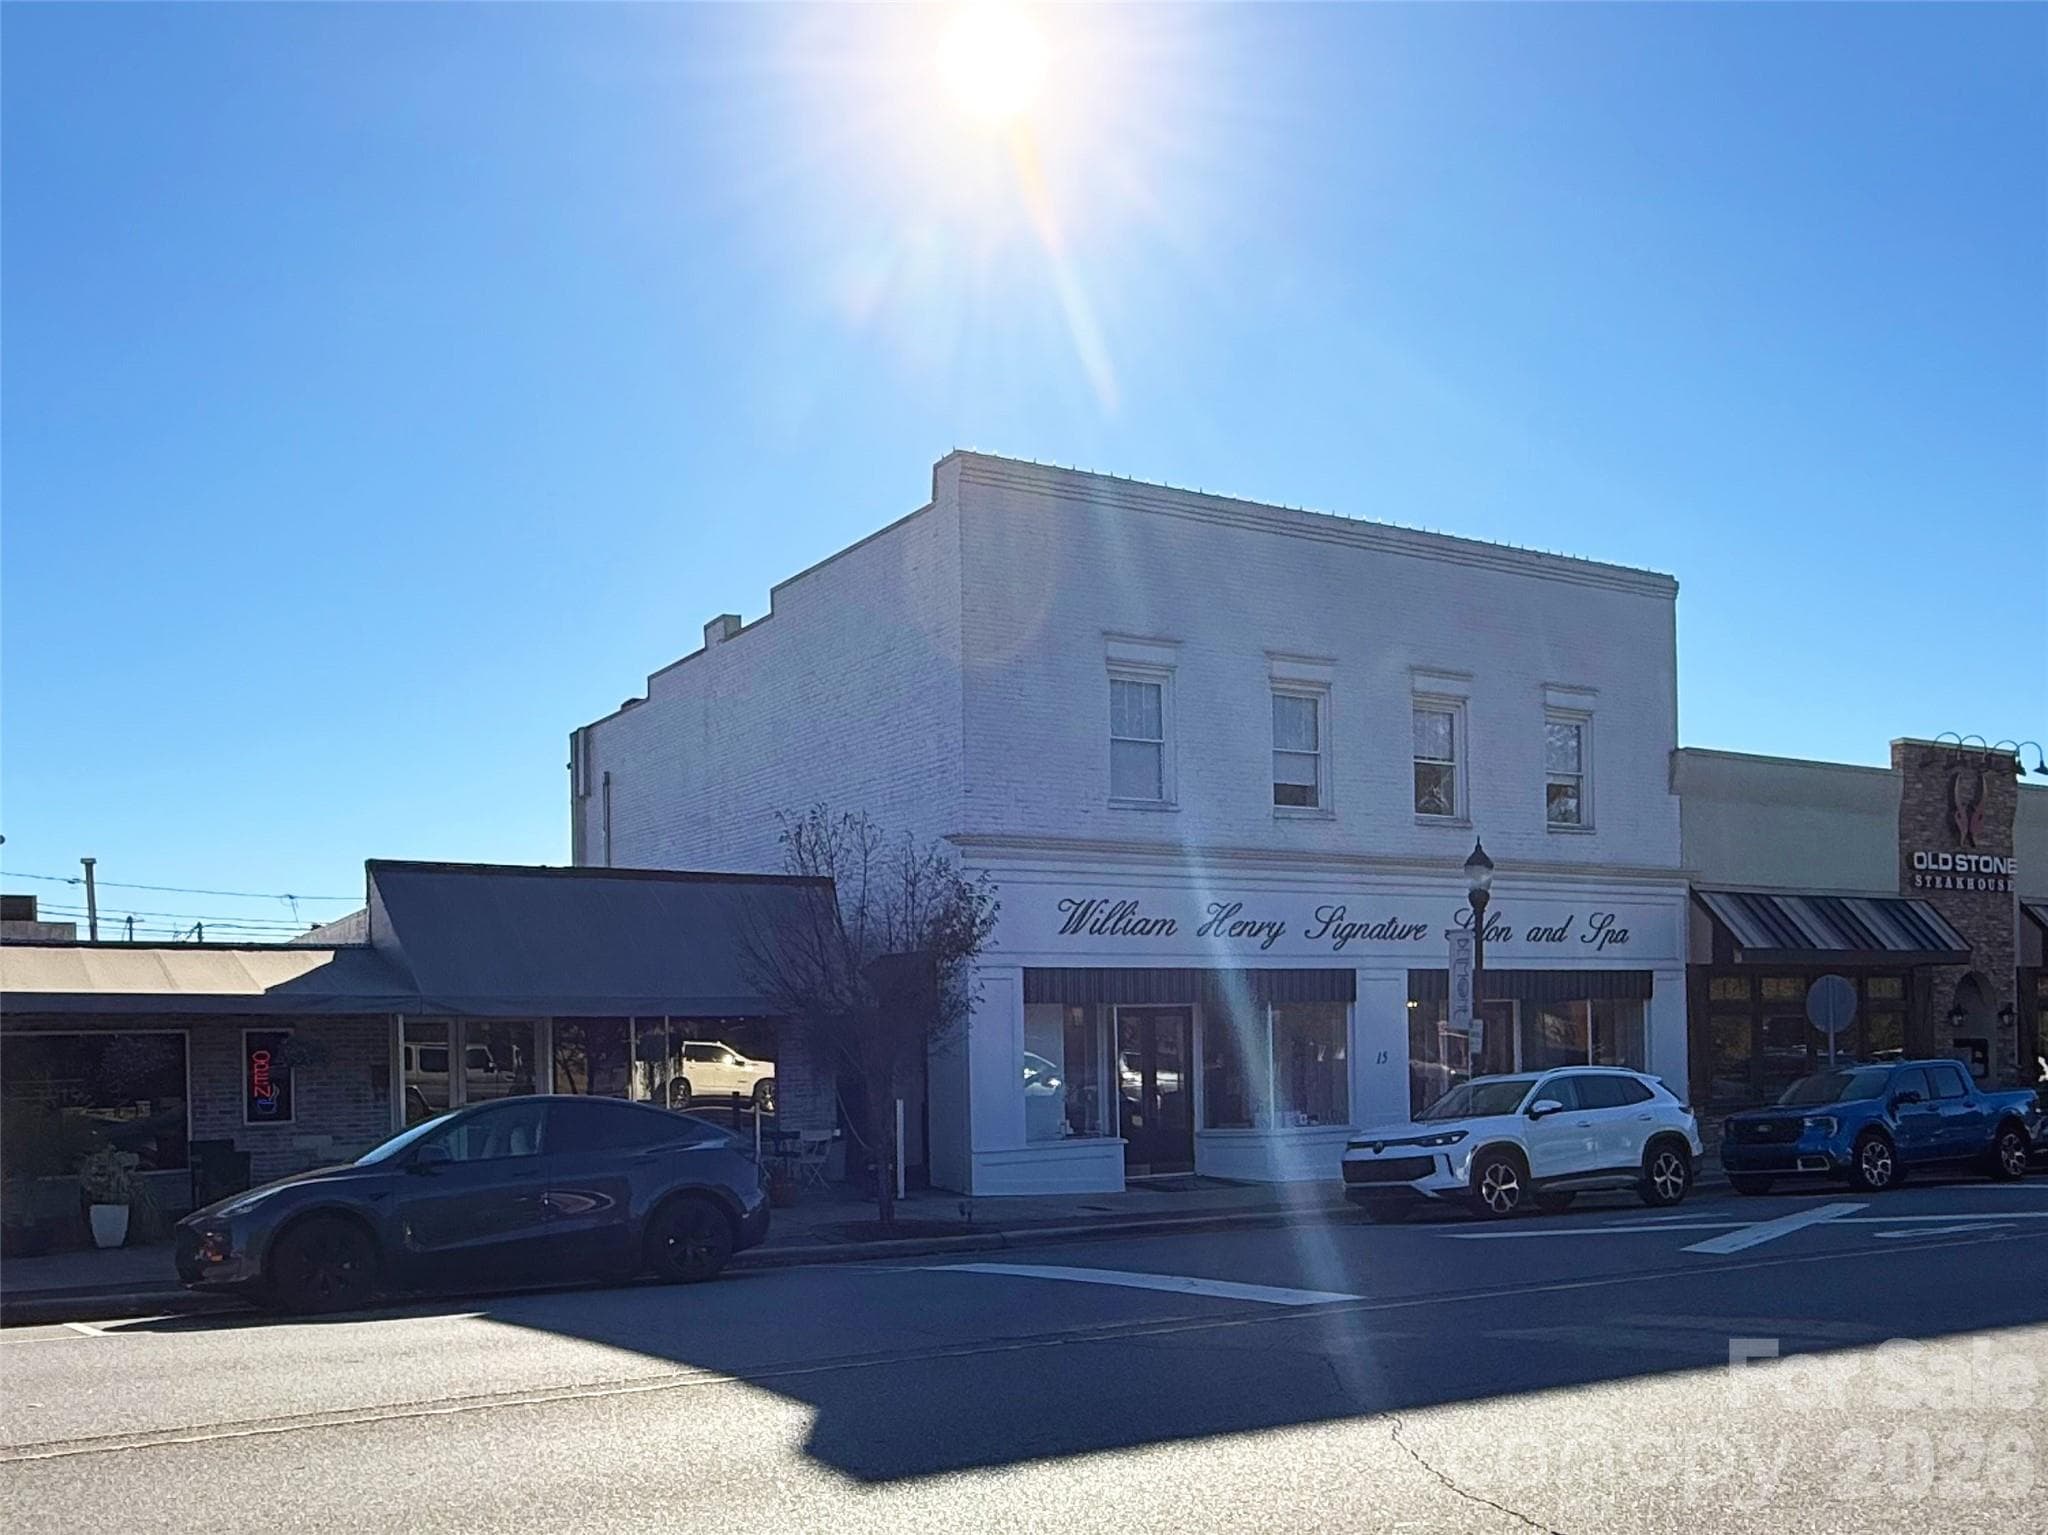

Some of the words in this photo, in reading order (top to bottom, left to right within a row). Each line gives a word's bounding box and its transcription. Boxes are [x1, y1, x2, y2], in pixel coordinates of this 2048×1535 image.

[1913, 851, 1952, 871] OLD
[1955, 854, 2018, 875] STONE
[1914, 874, 2015, 892] STEAKHOUSE
[1057, 898, 1178, 937] William
[1196, 902, 1286, 950] Henry
[1304, 905, 1429, 951] Signature
[1445, 908, 1514, 943] Slon
[1526, 914, 1574, 943] and
[1580, 912, 1630, 951] Spa
[1376, 1050, 1388, 1065] 15
[252, 1050, 271, 1098] OPEN
